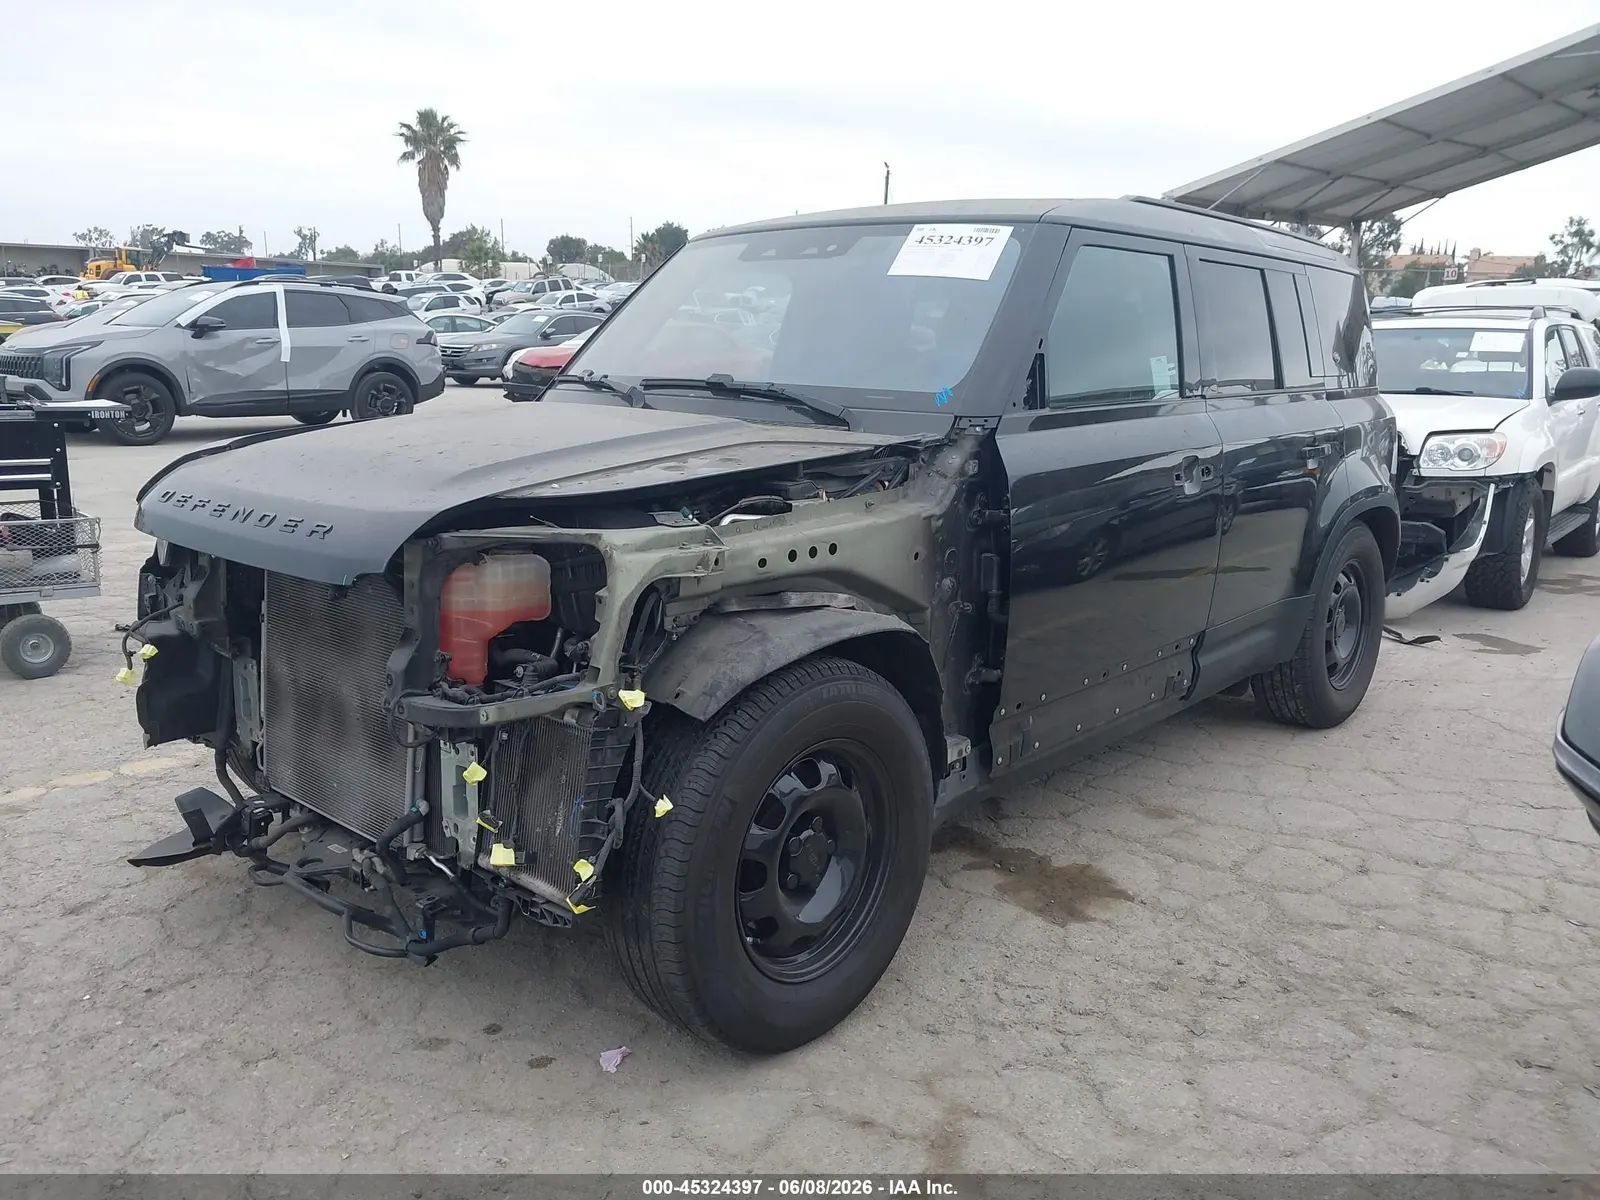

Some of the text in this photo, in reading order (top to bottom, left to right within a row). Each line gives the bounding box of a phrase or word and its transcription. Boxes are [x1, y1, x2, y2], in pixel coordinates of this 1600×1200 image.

[915, 234, 995, 247] 45324397
[91, 410, 126, 419] IRONTON
[158, 490, 334, 540] DEFENDER
